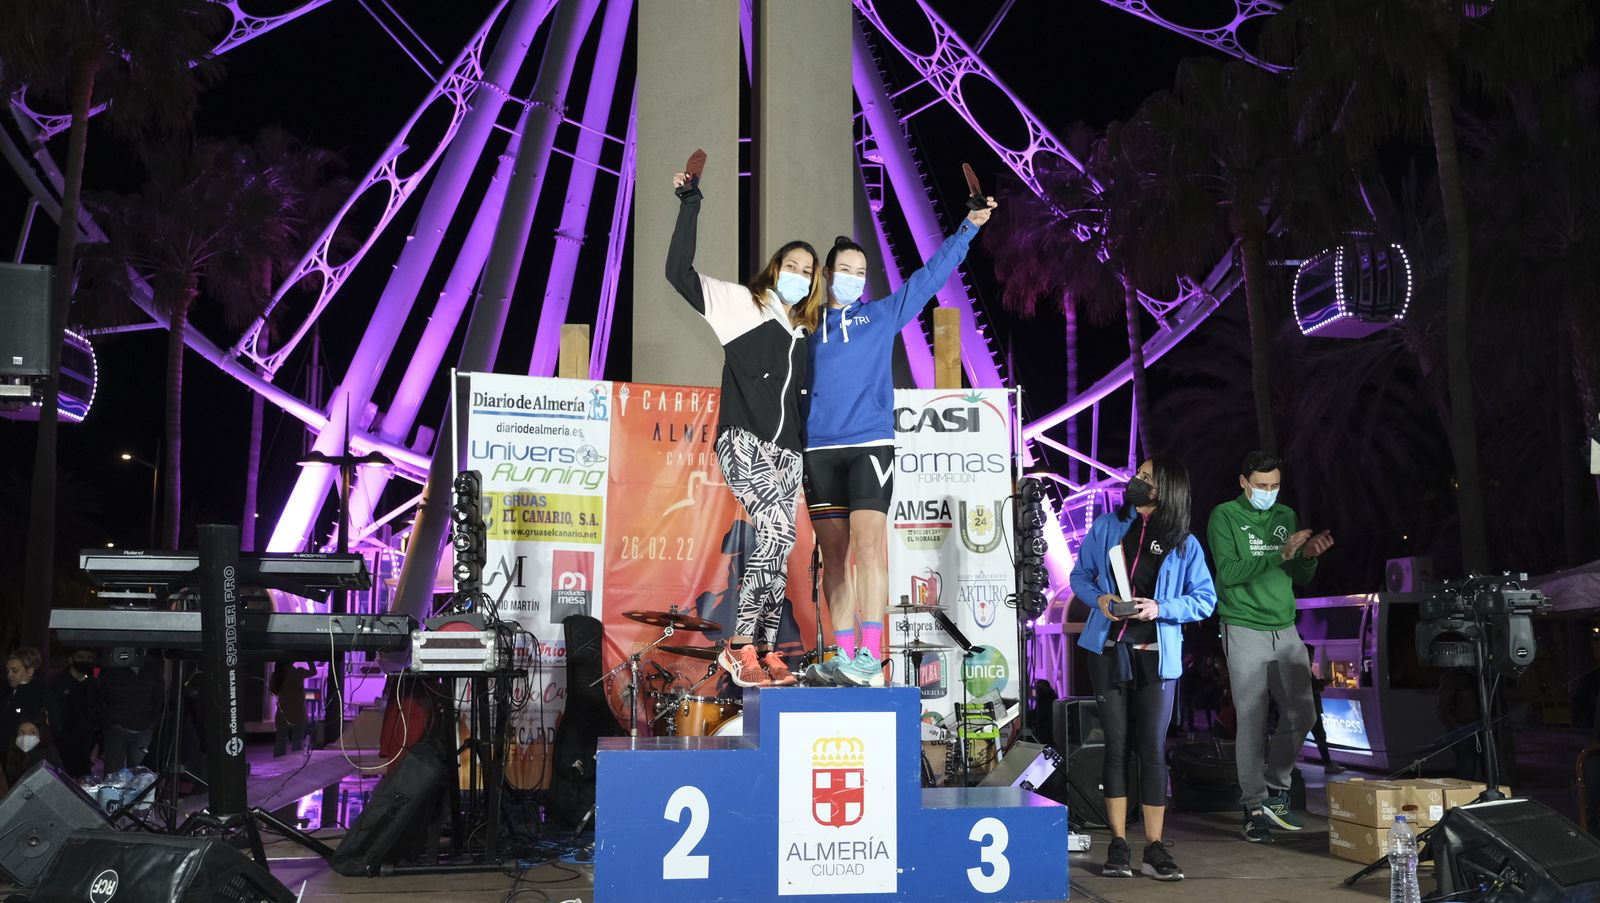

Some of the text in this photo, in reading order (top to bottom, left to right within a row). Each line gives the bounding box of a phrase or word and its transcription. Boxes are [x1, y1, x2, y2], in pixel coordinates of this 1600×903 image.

[853, 316, 870, 326] TRI
[473, 392, 585, 412] Diario de Almería
[643, 390, 715, 413] CARRE
[496, 422, 583, 437] diariodealmeria.es
[893, 407, 980, 433] CASI
[652, 422, 719, 443] ALME
[491, 463, 605, 490] Running
[918, 472, 976, 483] FORMACIÓN
[503, 494, 547, 507] GRUAS
[894, 499, 952, 520] AMSA
[503, 509, 599, 526] EL CANARIO, S.A.
[974, 517, 987, 527] 24
[503, 528, 597, 539] www.gruaselcanario.net
[622, 536, 694, 561] 26.02.22
[557, 595, 586, 604] mesa
[958, 585, 1008, 602] ARTURO
[510, 599, 540, 611] MARTÍN
[223, 565, 238, 666] SPIDER PRO
[229, 669, 237, 700] MEYER
[229, 706, 238, 734] KÖNIG
[663, 785, 709, 880] 2
[786, 835, 890, 861] ALMERÍA
[966, 817, 1010, 894] 3
[811, 863, 865, 876] CIUDAD
[92, 879, 117, 895] RCF
